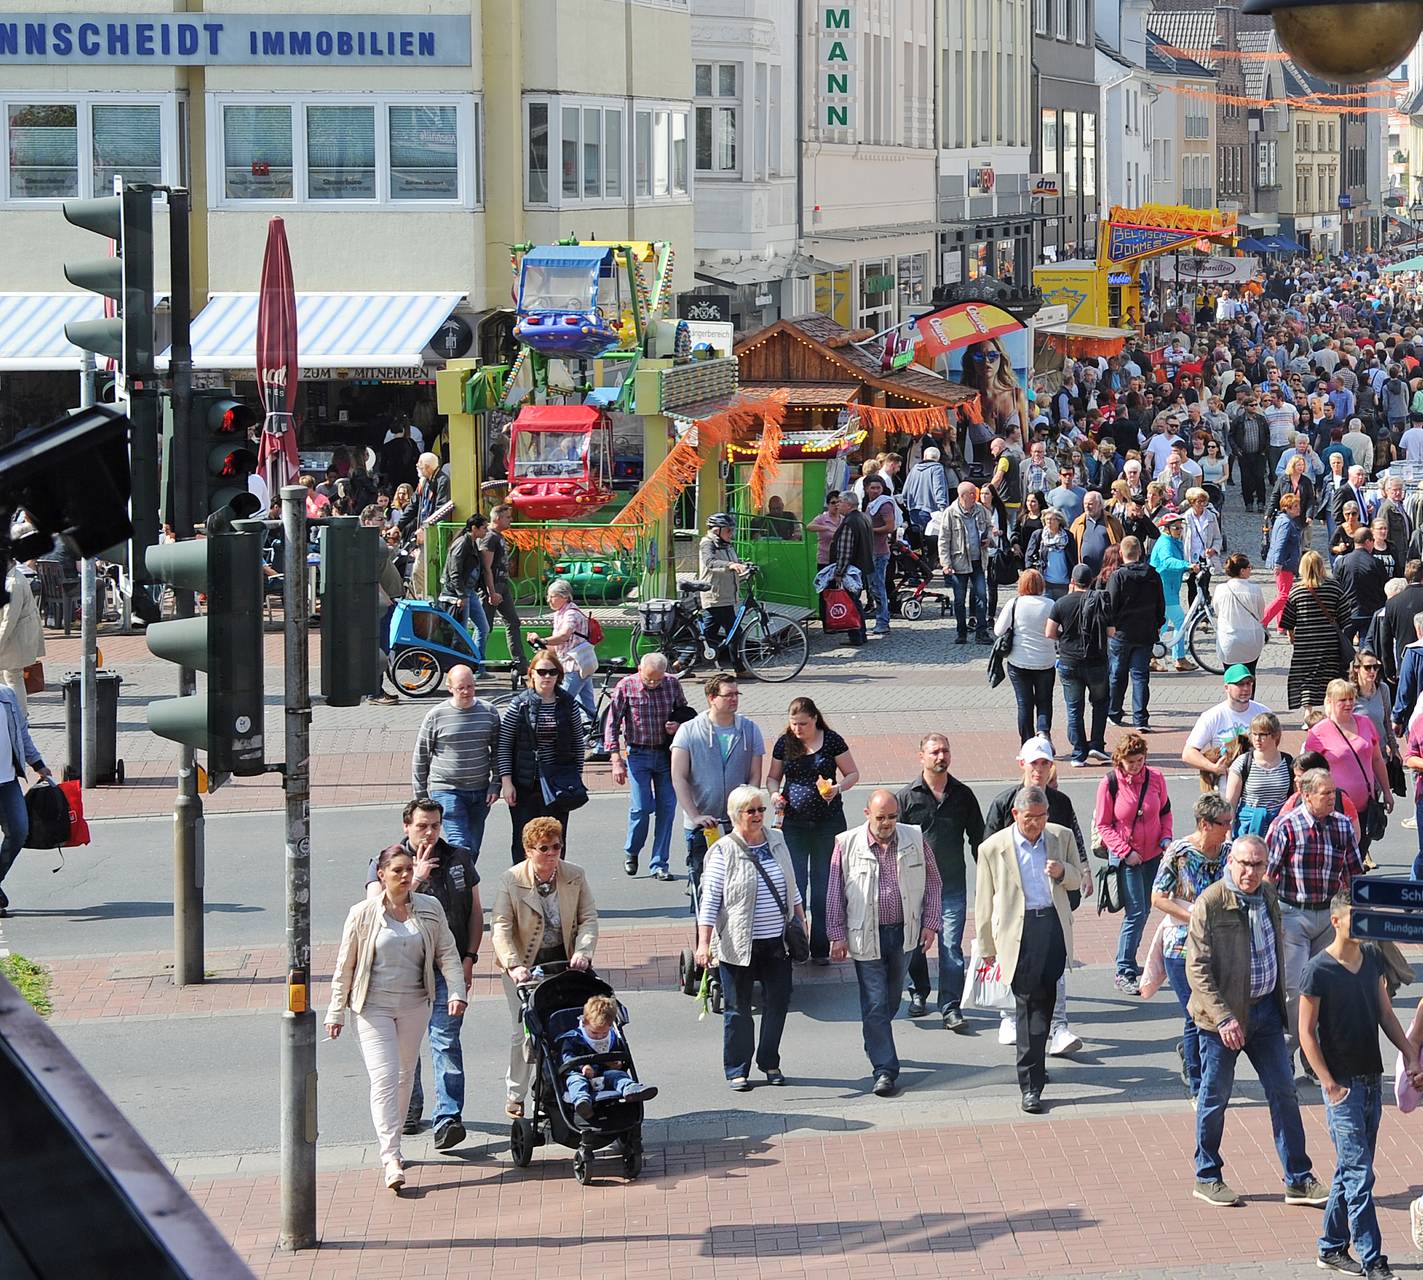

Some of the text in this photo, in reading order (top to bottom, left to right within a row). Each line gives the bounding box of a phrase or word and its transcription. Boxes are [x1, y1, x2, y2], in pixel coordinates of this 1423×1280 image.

[0, 23, 436, 57] NNSCHEIDT IMMOBILIEN
[825, 9, 850, 126] MANN
[1036, 177, 1056, 190] dm
[1112, 226, 1182, 243] BELGISCHE
[1112, 240, 1163, 260] POMMES
[303, 367, 430, 379] ZUM MITNEHMEN
